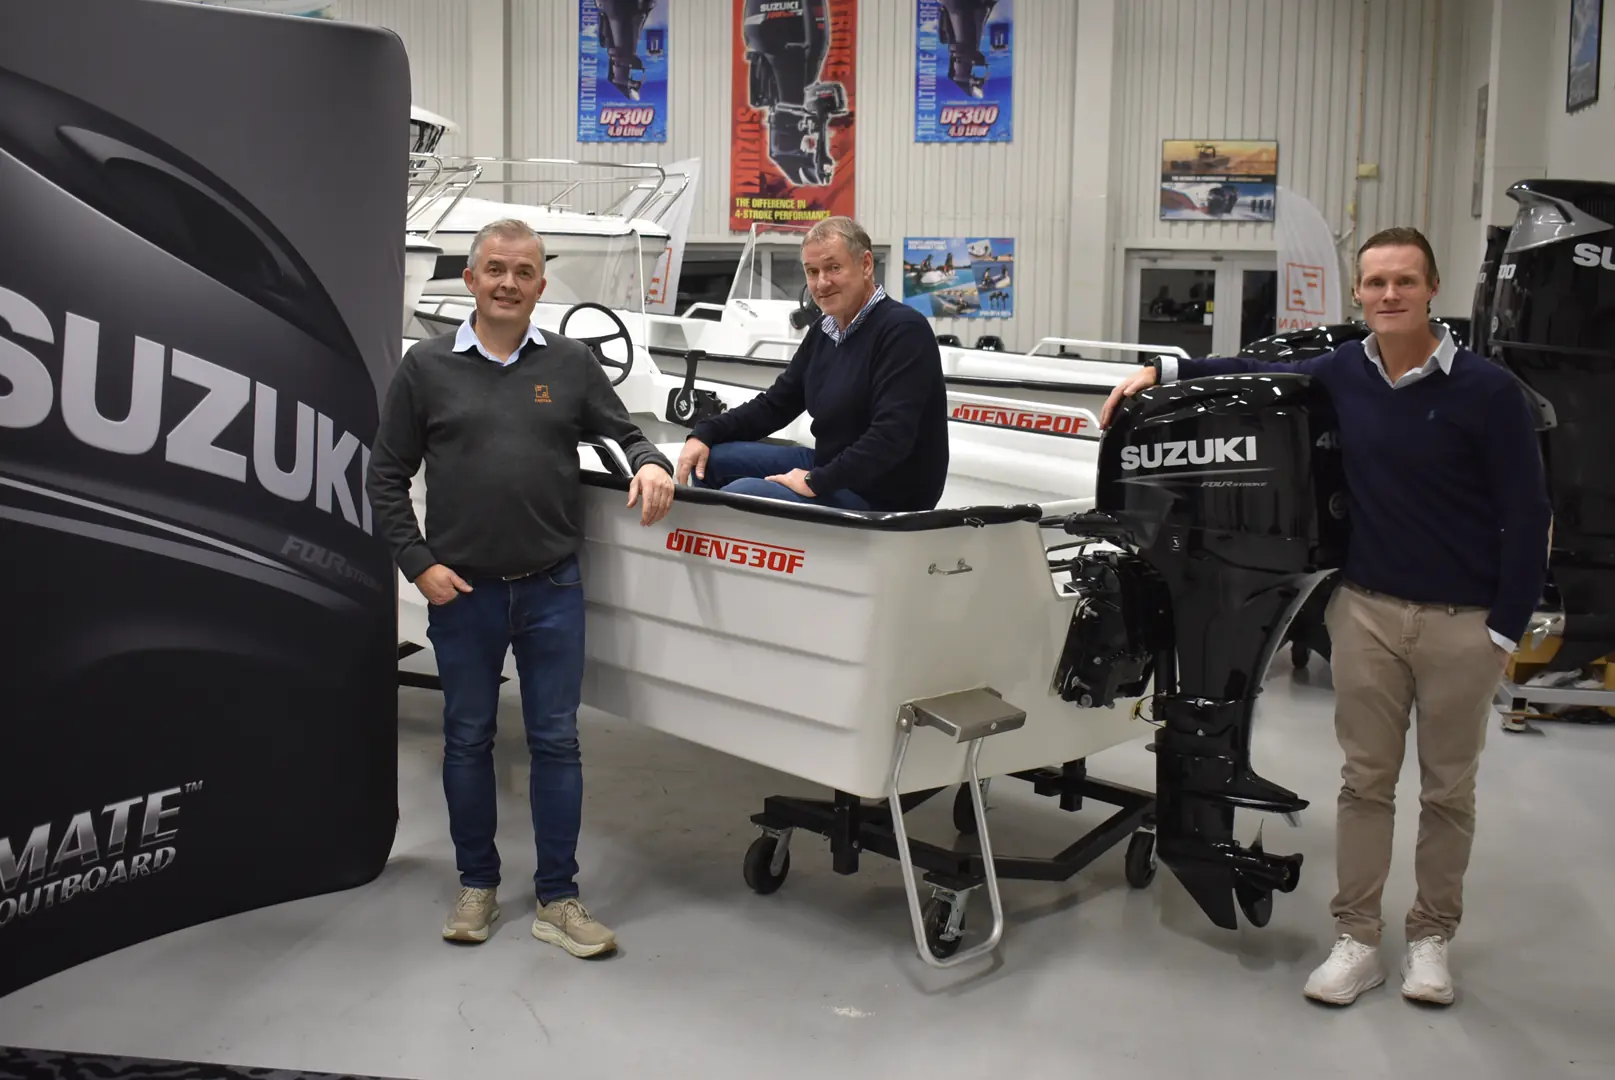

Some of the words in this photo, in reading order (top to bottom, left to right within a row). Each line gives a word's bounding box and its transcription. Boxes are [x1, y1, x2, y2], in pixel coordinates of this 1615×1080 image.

[581, 59, 597, 111] ULTIMATE
[918, 53, 936, 110] ULTIMATE
[580, 115, 596, 136] THE
[599, 107, 655, 125] DF300
[918, 114, 936, 136] THE
[940, 105, 998, 124] DF300
[735, 107, 760, 194] SUZUKI
[735, 198, 751, 208] THE
[752, 198, 795, 209] DIFFERENCE
[797, 199, 807, 209] IN
[735, 209, 773, 220] 4-STROKE
[1120, 435, 1257, 470] SUZUKI
[0, 846, 177, 926] OUTBOARD
